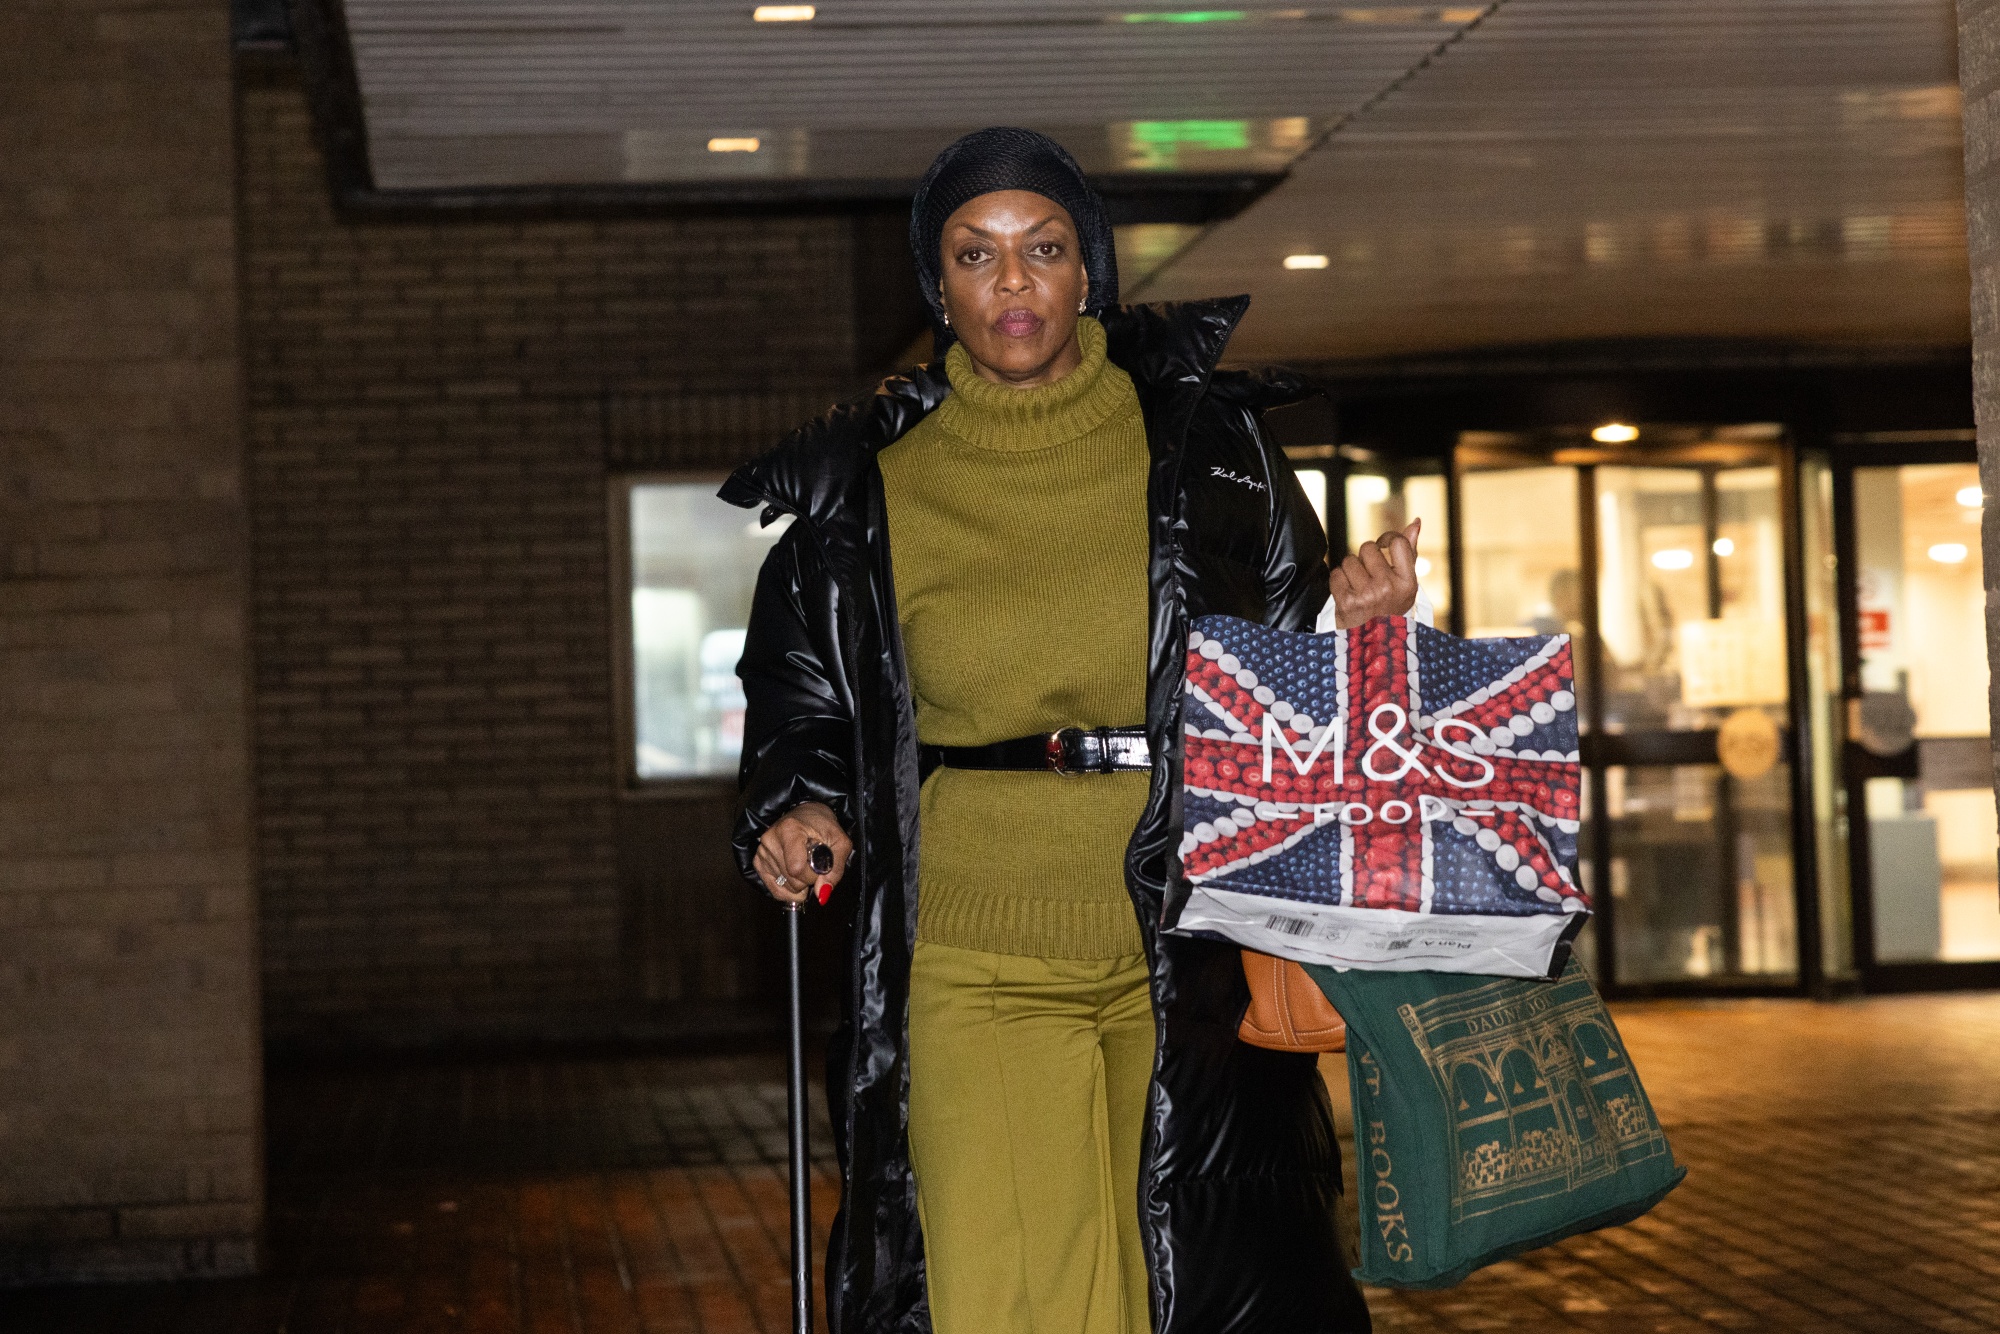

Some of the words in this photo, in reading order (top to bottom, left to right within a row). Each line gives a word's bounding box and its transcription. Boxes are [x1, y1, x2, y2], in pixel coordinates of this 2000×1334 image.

[1262, 703, 1495, 788] M&S
[1314, 794, 1448, 826] FOOD
[1368, 1119, 1413, 1263] BOOKS
